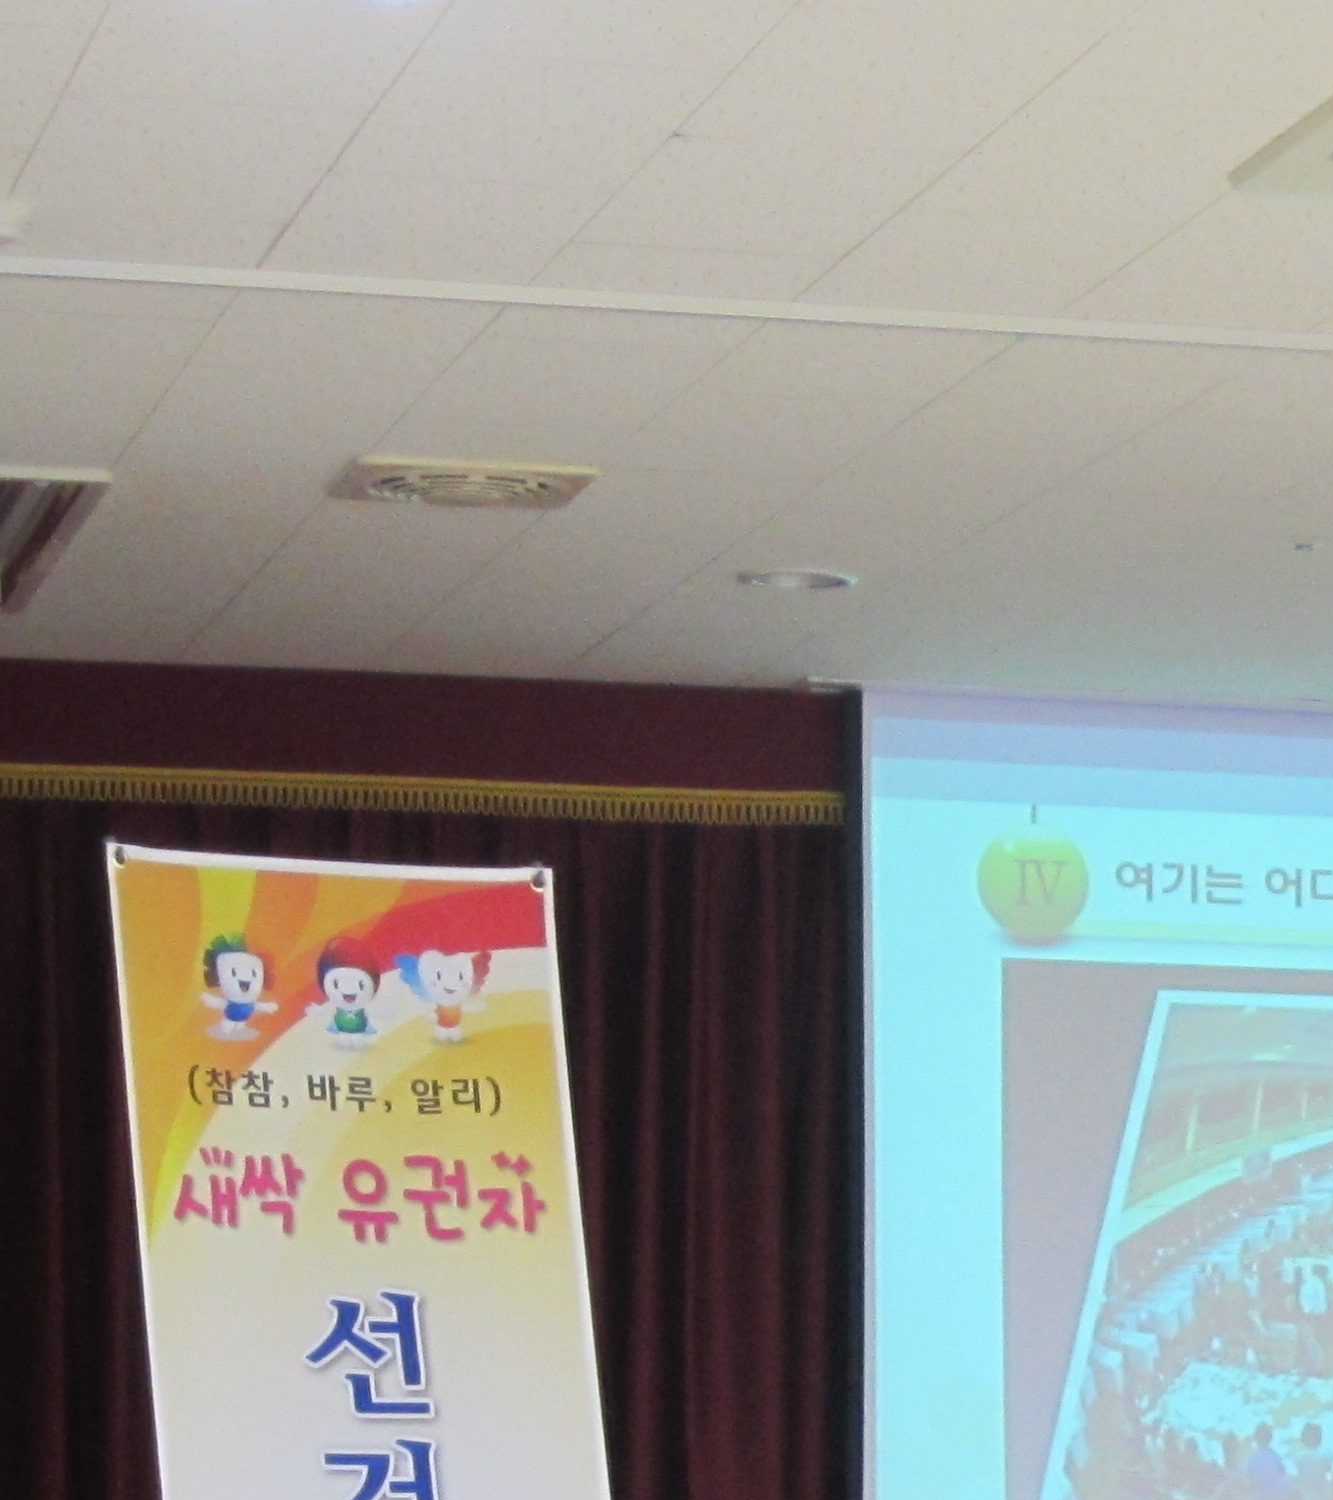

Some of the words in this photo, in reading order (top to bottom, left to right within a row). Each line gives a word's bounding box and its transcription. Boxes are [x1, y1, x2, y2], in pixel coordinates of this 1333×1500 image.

[1114, 859, 1245, 907] 여기는
[187, 1063, 290, 1109] (참참,
[306, 1073, 393, 1114] 바루,
[409, 1075, 502, 1117] 알리)
[173, 1145, 305, 1237] 새싹
[337, 1150, 549, 1244] 유권자
